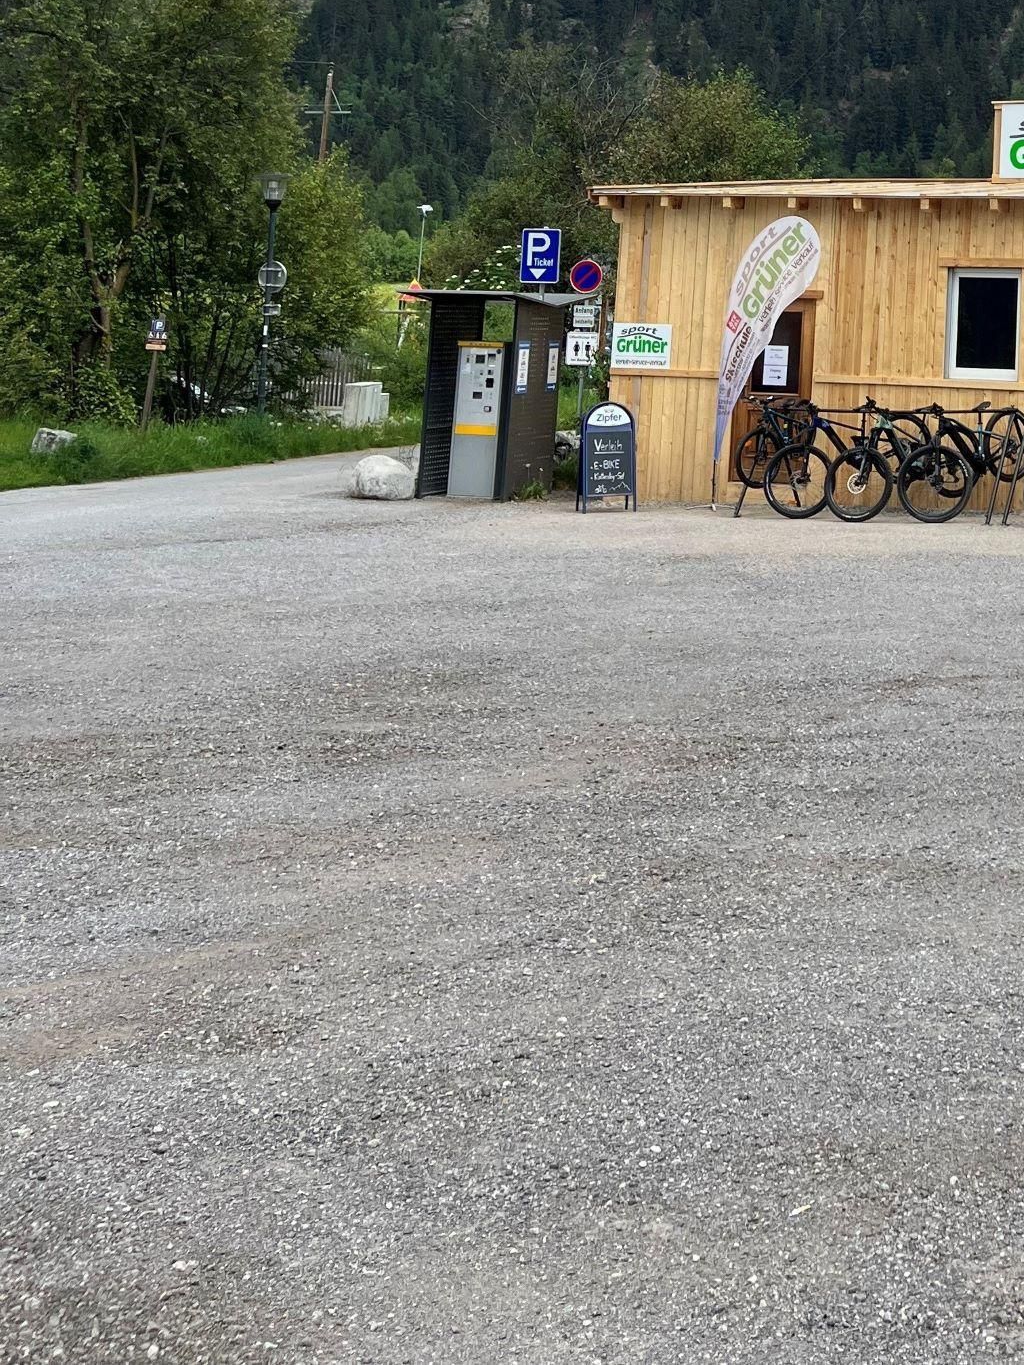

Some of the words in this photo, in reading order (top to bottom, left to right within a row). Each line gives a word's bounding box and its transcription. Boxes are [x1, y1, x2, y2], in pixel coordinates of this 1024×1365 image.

[526, 232, 551, 266] P
[534, 257, 554, 267] Ticket
[736, 226, 778, 296] sport
[743, 221, 806, 318] Grüner
[621, 326, 658, 334] sport
[616, 335, 668, 353] Grüner
[596, 414, 622, 423] Zipfer
[593, 438, 623, 452] Verleih
